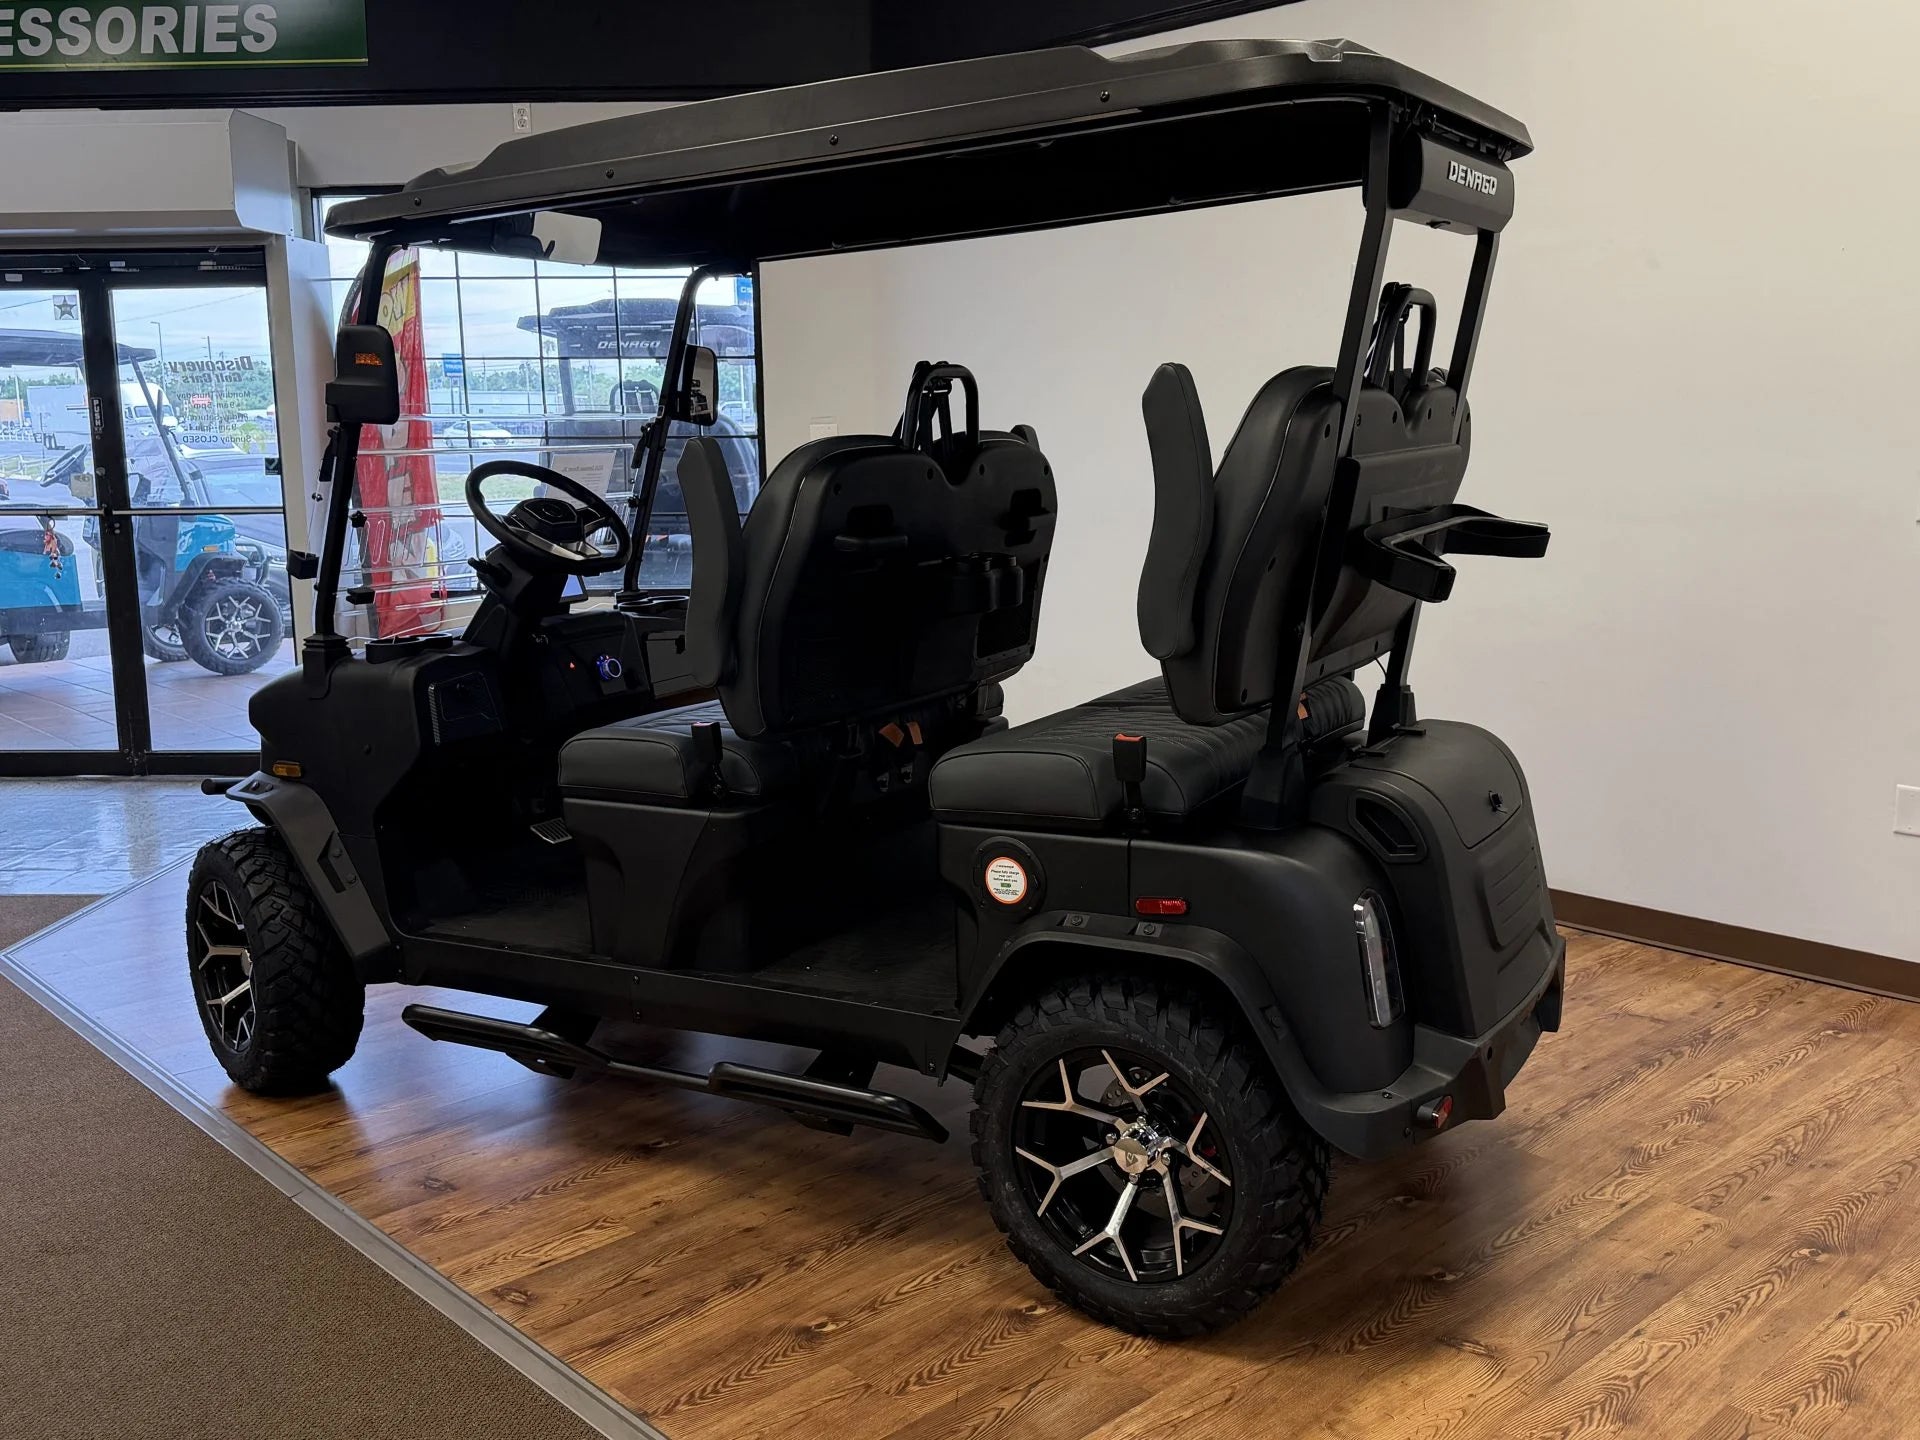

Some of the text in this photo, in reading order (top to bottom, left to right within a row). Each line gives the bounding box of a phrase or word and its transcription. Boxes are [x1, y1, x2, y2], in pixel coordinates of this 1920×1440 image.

[1447, 160, 1498, 195] DENAGO
[597, 340, 660, 349] DENAGO
[93, 399, 101, 426] PUSH
